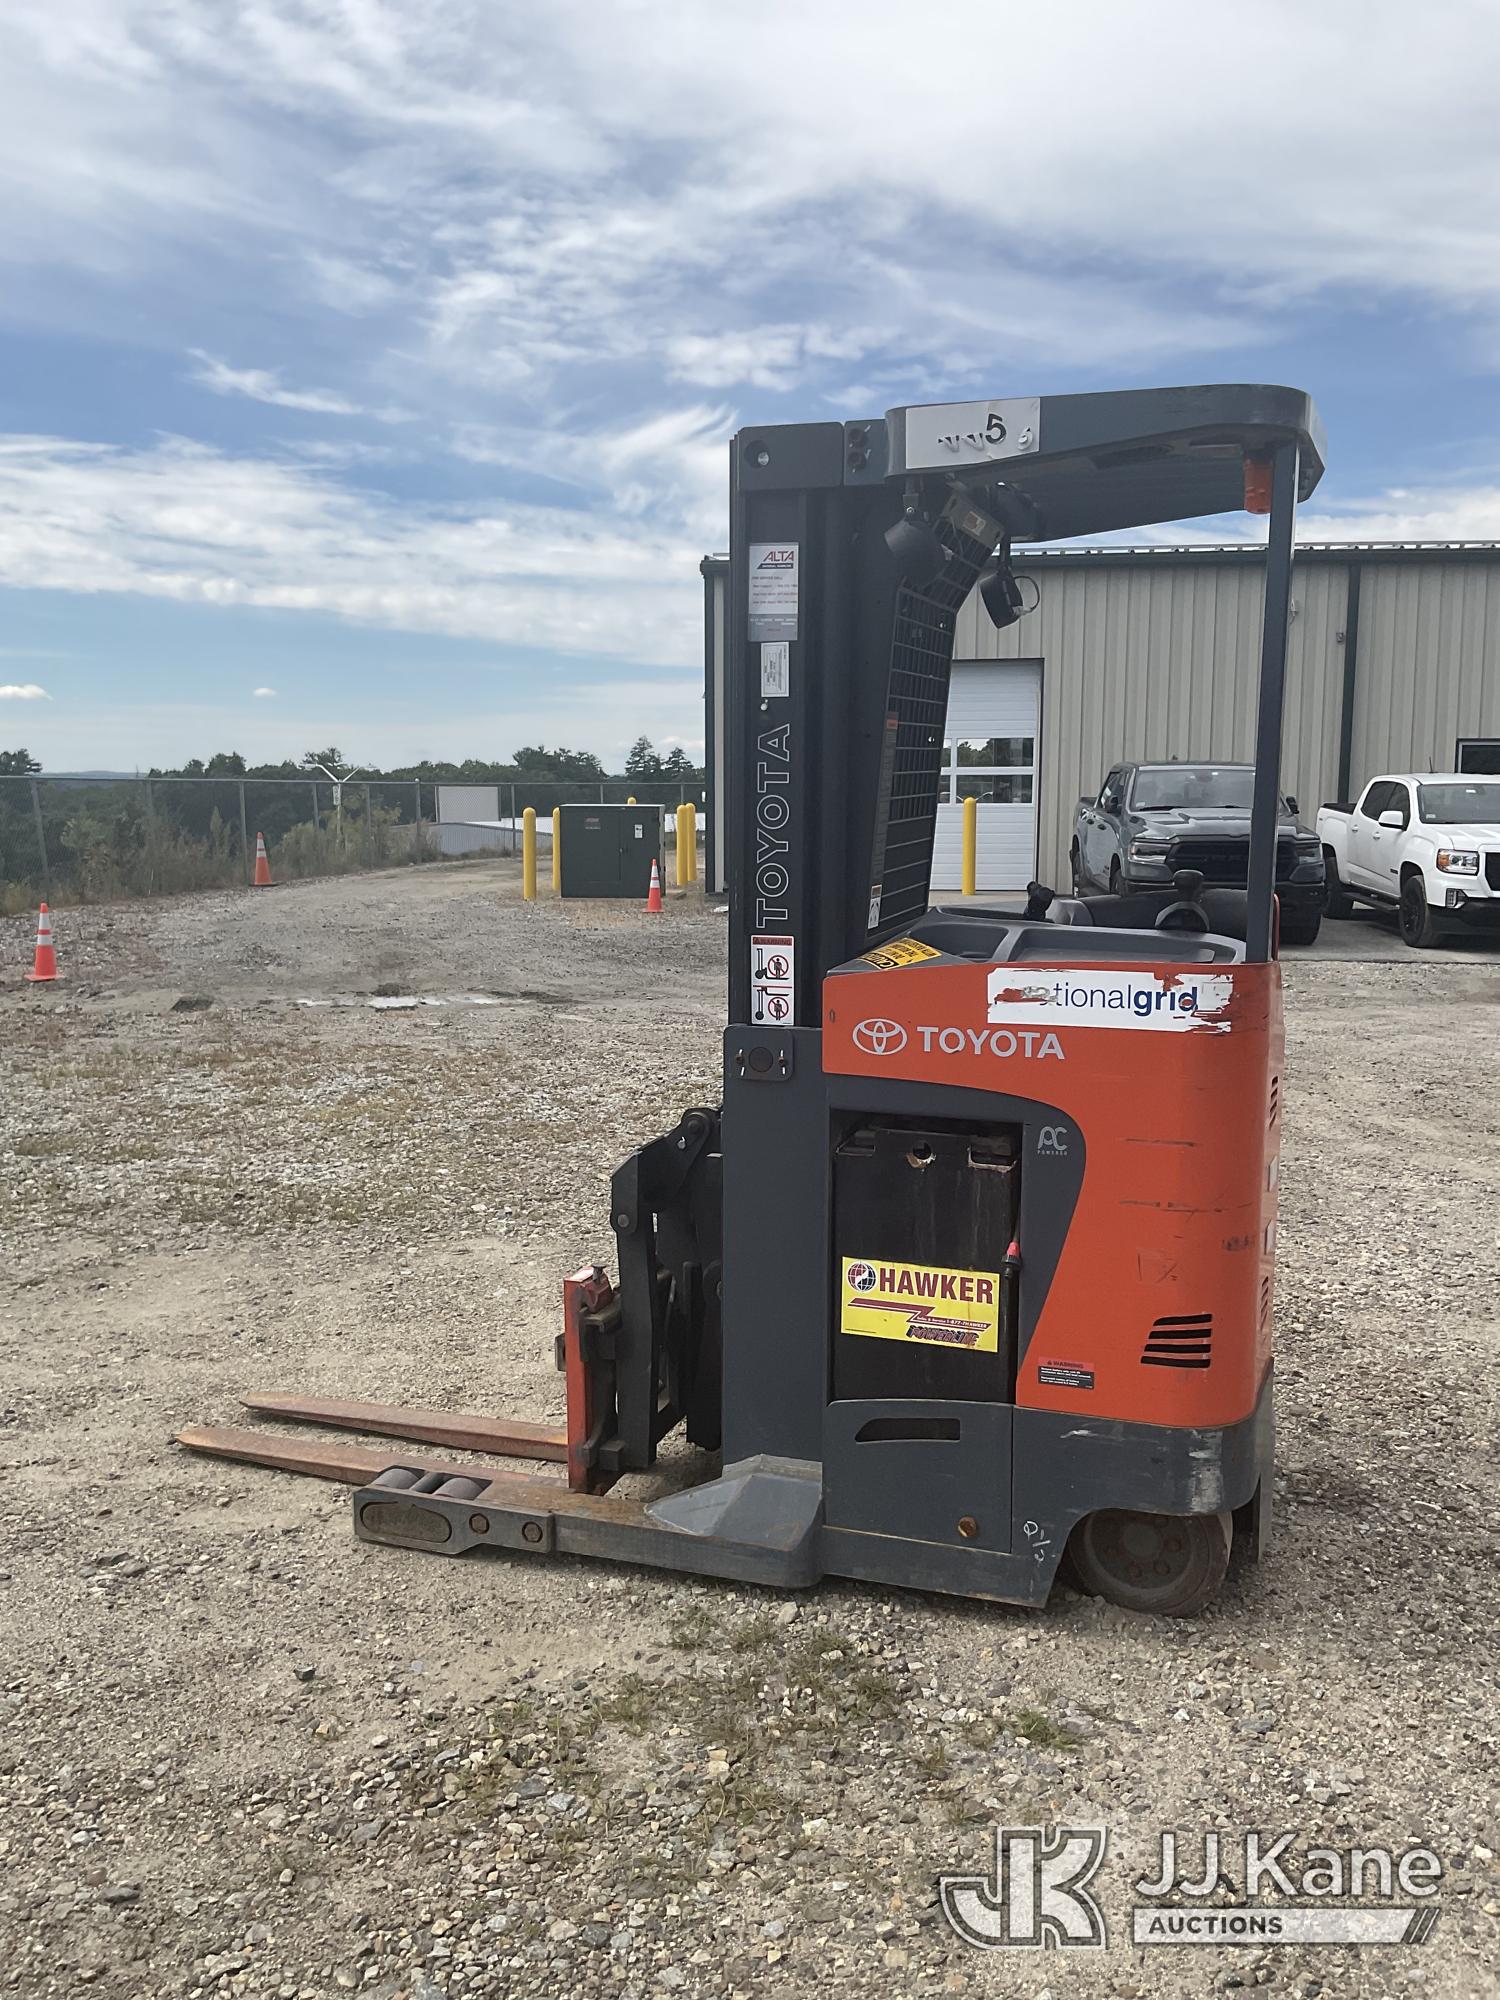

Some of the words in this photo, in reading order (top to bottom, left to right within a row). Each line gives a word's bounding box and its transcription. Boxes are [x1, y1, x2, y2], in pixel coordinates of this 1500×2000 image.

[763, 551, 795, 561] ALTA
[756, 723, 790, 928] TOYOTA
[994, 981, 1199, 1017] tionalgrid
[916, 1026, 1065, 1060] TOYOTA
[1037, 1126, 1068, 1150] AC
[879, 1267, 994, 1305] HAWKER
